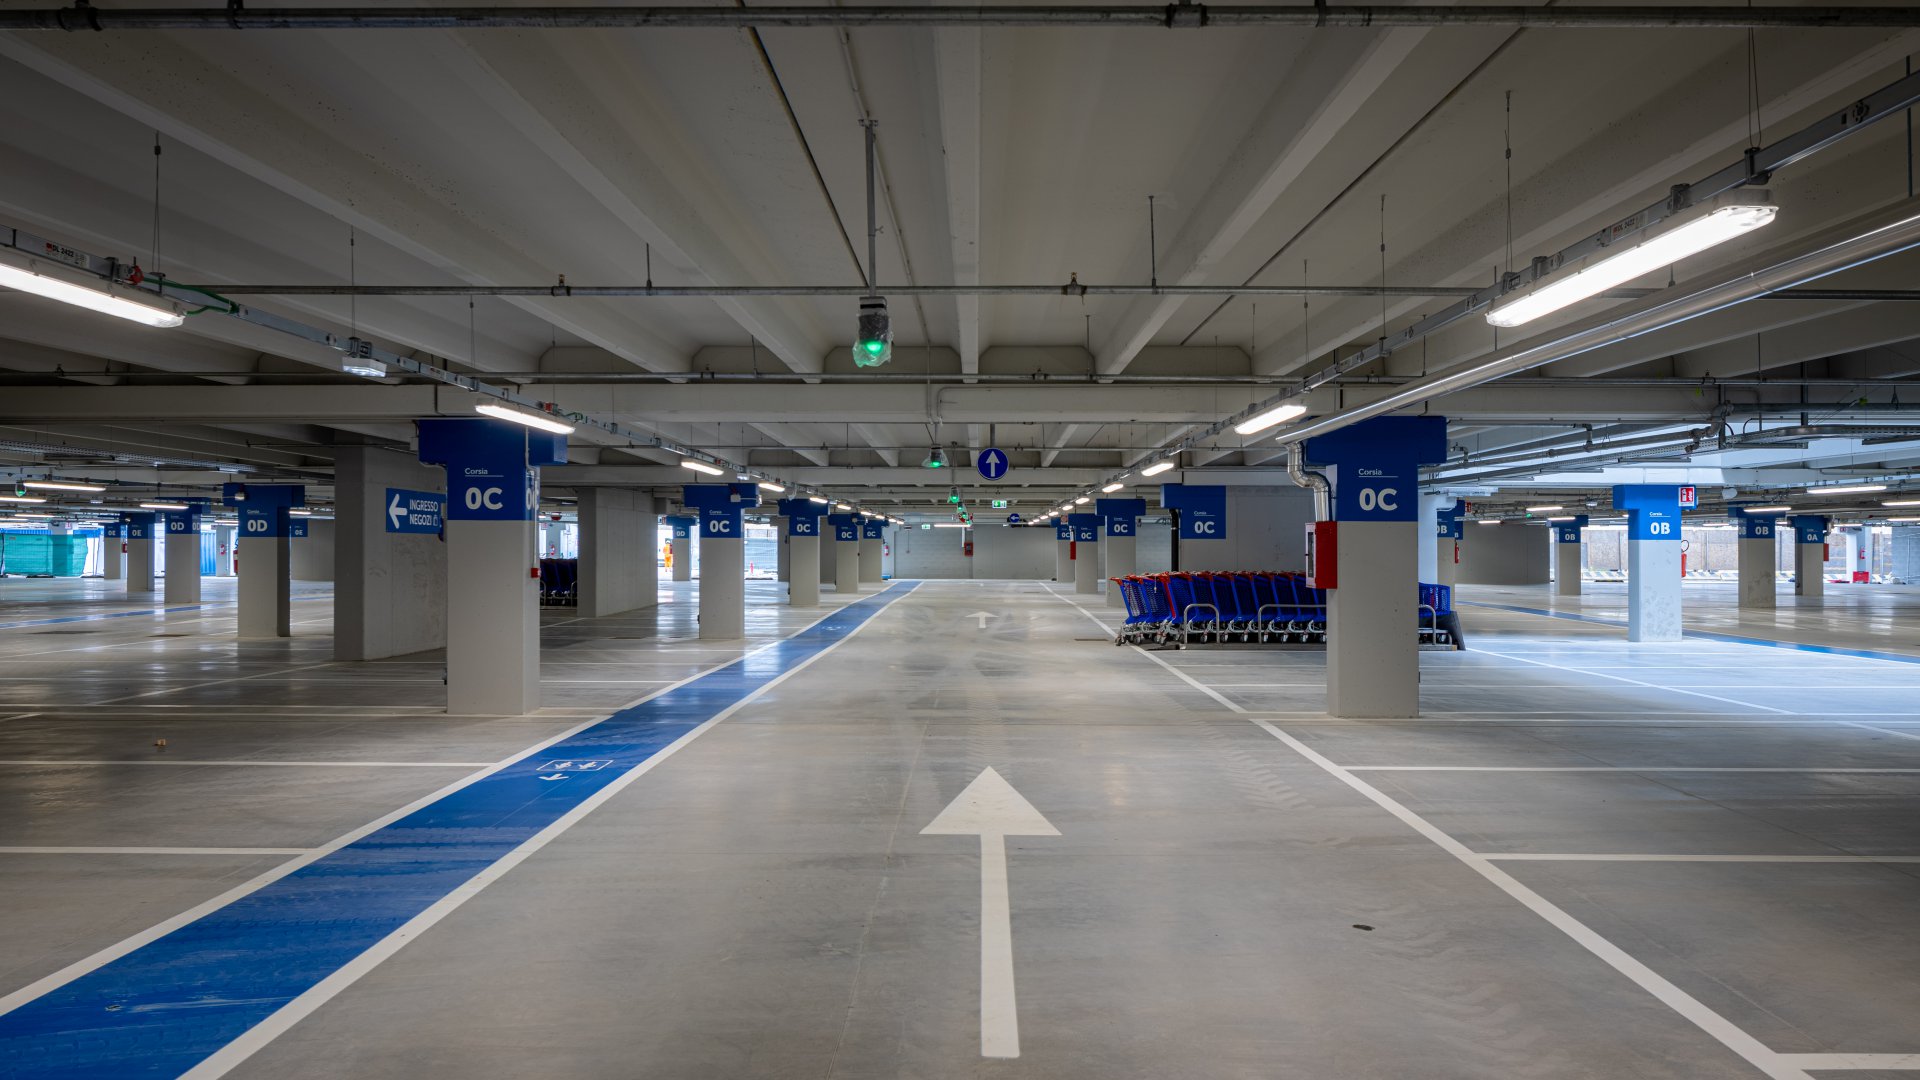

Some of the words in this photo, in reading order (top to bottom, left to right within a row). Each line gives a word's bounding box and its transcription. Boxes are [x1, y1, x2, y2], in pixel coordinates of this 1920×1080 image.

[464, 467, 488, 475] Corsia
[465, 487, 503, 510] 0C
[1359, 488, 1398, 511] 0C
[409, 499, 439, 512] INGRESSO
[247, 520, 268, 532] 0D
[409, 514, 432, 526] NEGOZI
[170, 522, 185, 531] 0D
[709, 520, 730, 533] 0C
[796, 523, 811, 533] 0C
[1113, 524, 1128, 533] 0C
[1194, 521, 1215, 534] 0C
[1650, 522, 1671, 535] 0B
[1755, 526, 1769, 535] 0B
[1081, 532, 1092, 540] 0C
